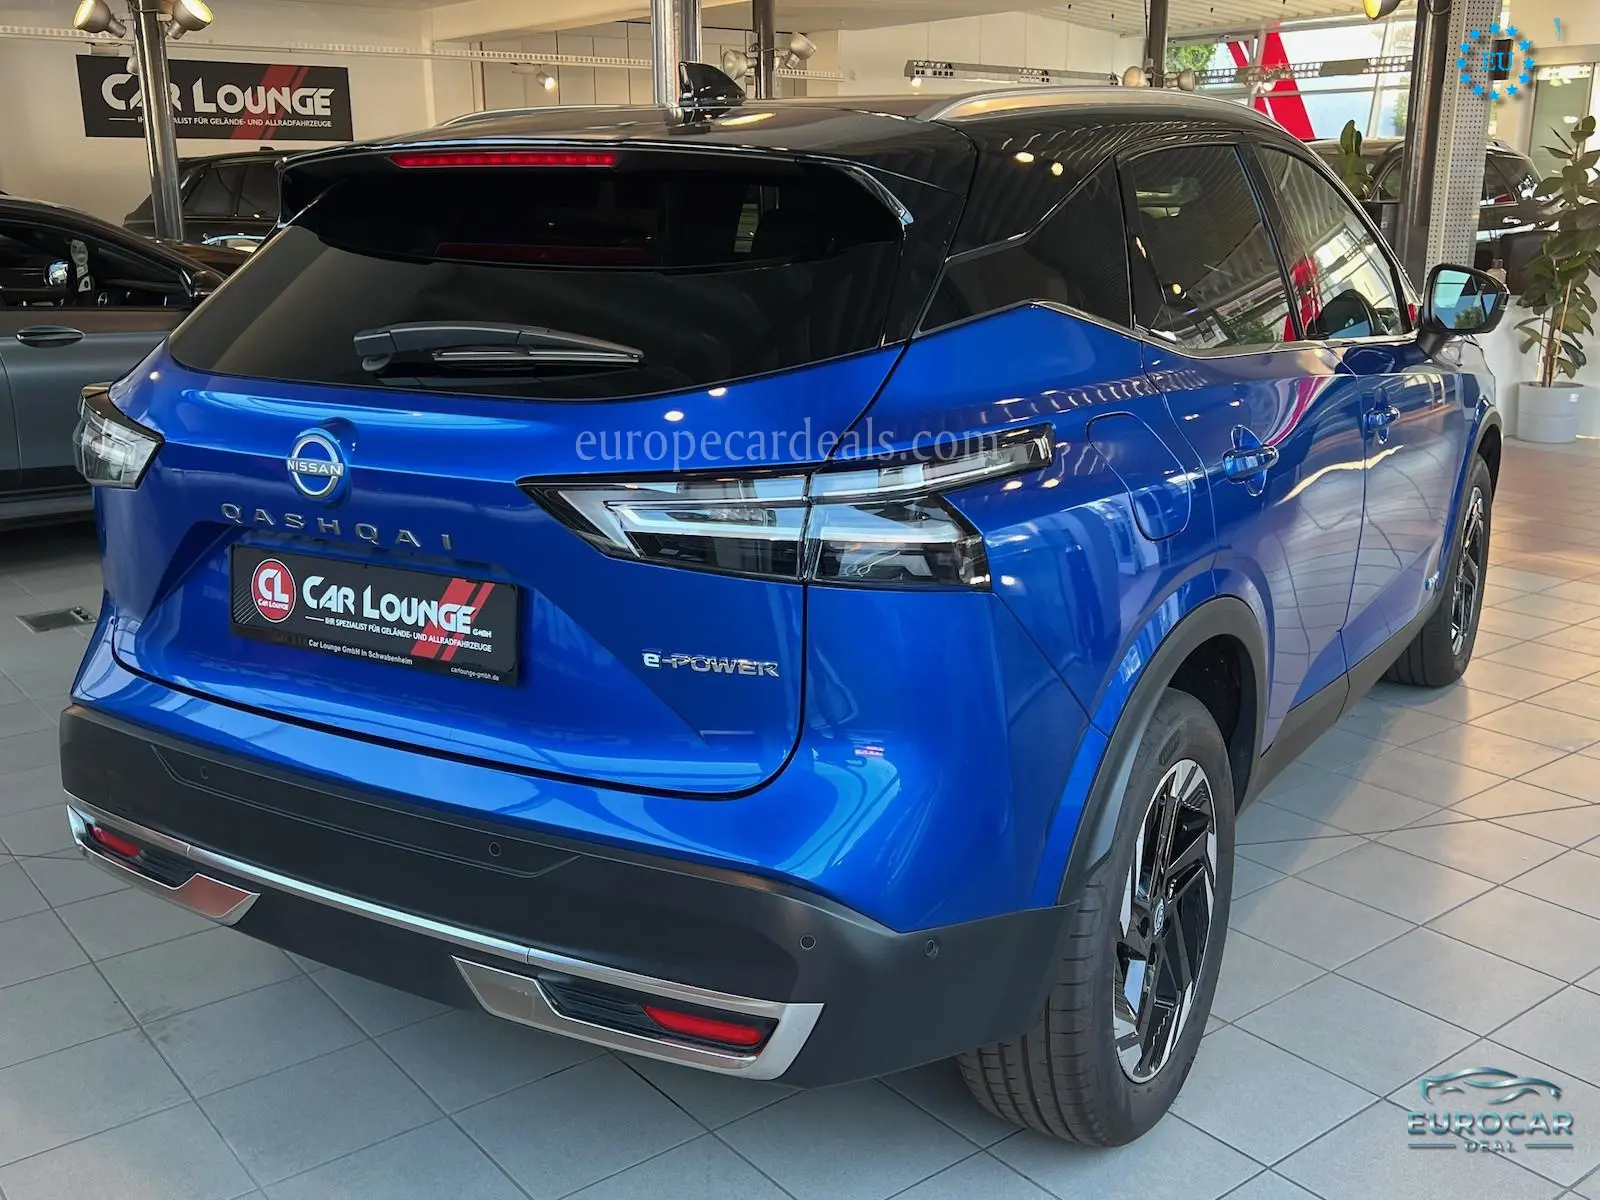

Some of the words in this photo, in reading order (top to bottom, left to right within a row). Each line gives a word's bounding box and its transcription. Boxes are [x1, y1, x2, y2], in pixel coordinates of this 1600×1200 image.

[194, 116, 209, 125] FÜR
[210, 116, 246, 126] GELÄNDE-
[247, 119, 264, 127] UND
[264, 119, 332, 128] ALLRADFAHRZEUGE
[287, 459, 343, 476] NISSAN
[220, 503, 453, 551] QASHQAI
[258, 568, 289, 603] CL
[325, 617, 335, 625] IHR
[335, 618, 368, 632] SPEZIALIST
[368, 623, 381, 634] FÜR
[381, 626, 412, 638] GELÄNDE-
[413, 632, 427, 641] UND
[427, 635, 492, 653] ALLRADFAHRZEUGE
[308, 639, 319, 648] Car
[319, 641, 341, 653] Lounge
[341, 645, 360, 656] GmbH
[361, 648, 367, 657] in
[367, 650, 413, 665] Schwabenheim
